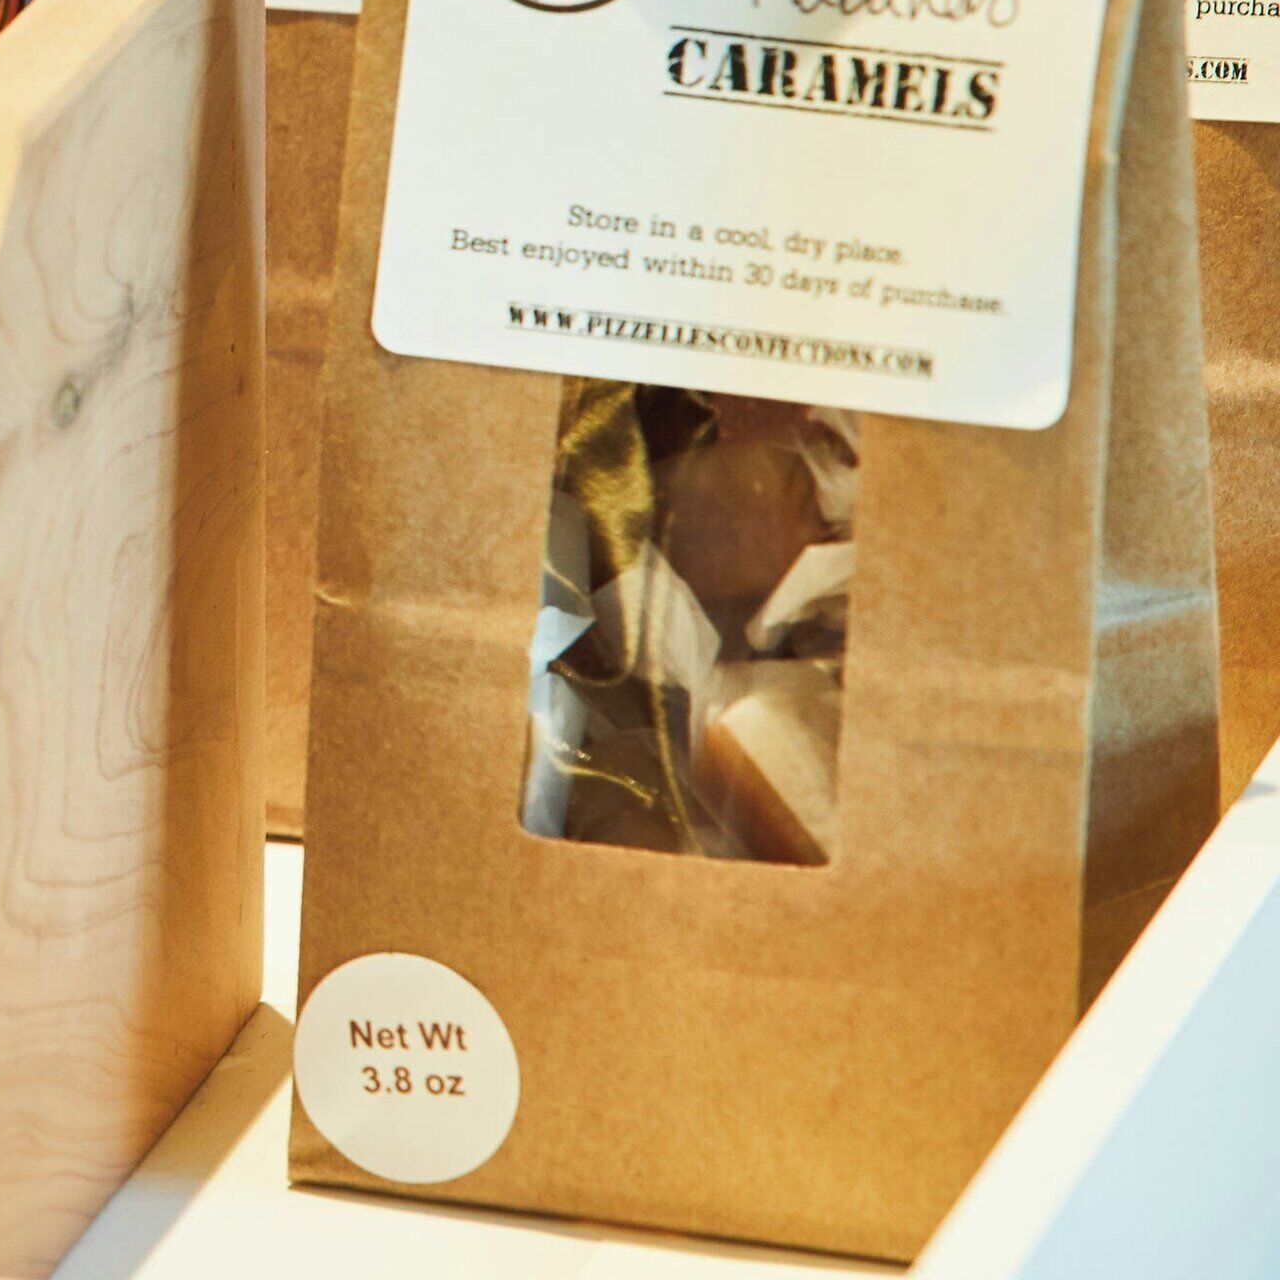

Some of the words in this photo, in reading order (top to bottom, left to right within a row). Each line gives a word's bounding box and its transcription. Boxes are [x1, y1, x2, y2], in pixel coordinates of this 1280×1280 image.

[667, 36, 1001, 120] CARAMELS
[568, 204, 639, 234] Store
[650, 213, 676, 238] in
[688, 225, 703, 241] a
[784, 230, 827, 260] dry
[451, 229, 509, 255] Best
[522, 241, 629, 269] enjoyed
[643, 255, 733, 282] within
[744, 262, 774, 286] 30
[781, 269, 839, 297] days
[849, 277, 874, 298] of
[349, 1020, 409, 1049] Net
[419, 1022, 467, 1051] Wt
[362, 1066, 413, 1094] 3.8
[425, 1074, 466, 1097] oz
